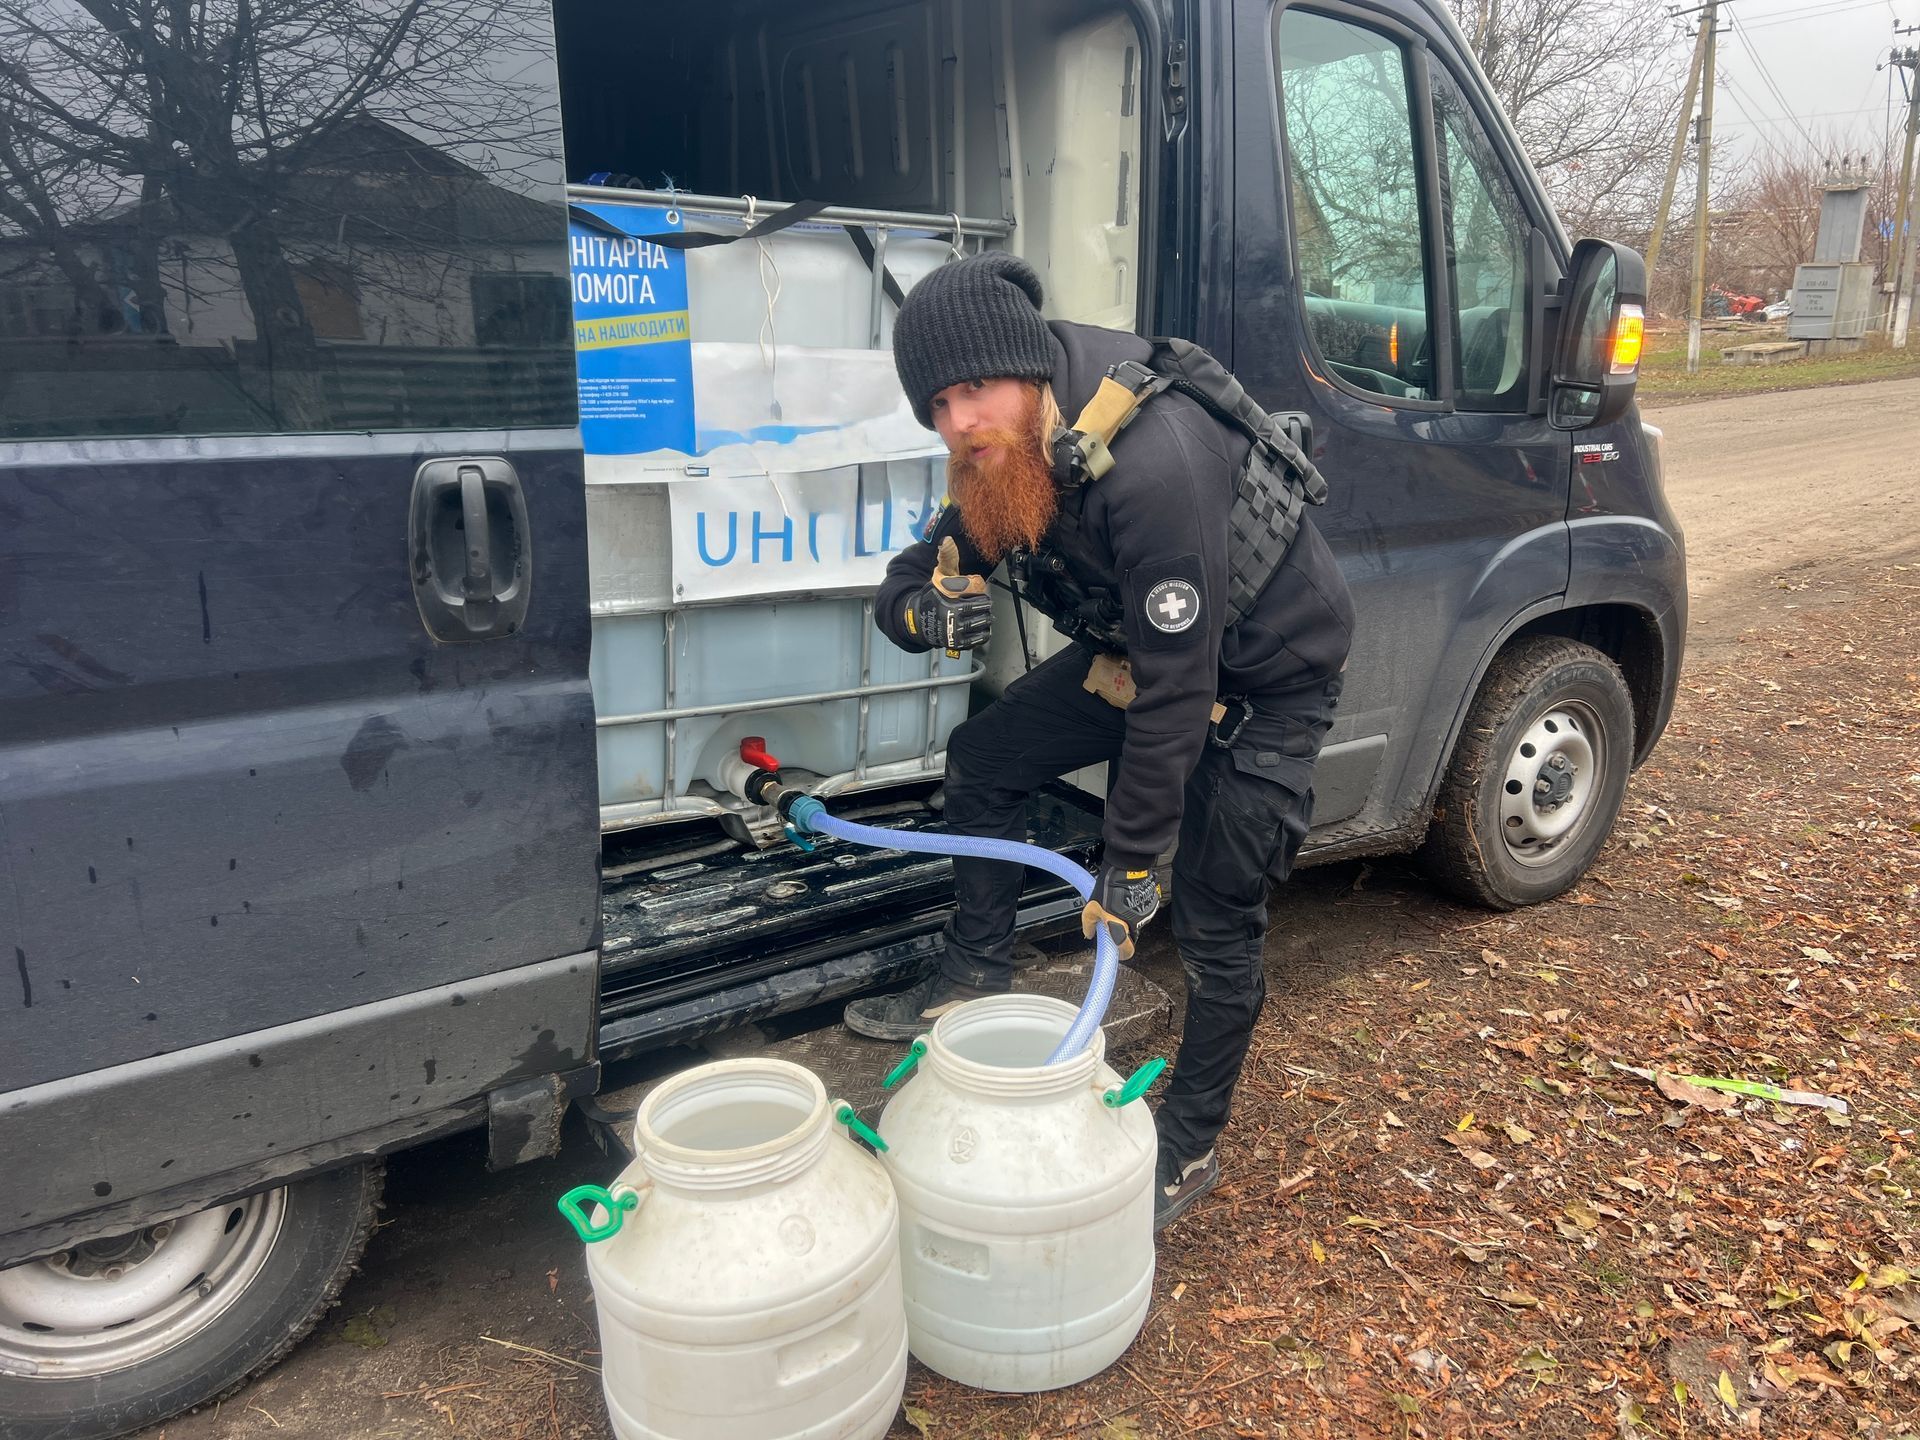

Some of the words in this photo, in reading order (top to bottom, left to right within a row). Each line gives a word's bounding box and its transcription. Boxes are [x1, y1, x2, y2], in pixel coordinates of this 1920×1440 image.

[569, 236, 669, 269] НІТАРНА
[599, 318, 685, 341] НАШКОДИТИ
[1574, 444, 1601, 453] INDUSTRIAL
[1601, 443, 1613, 451] CARS
